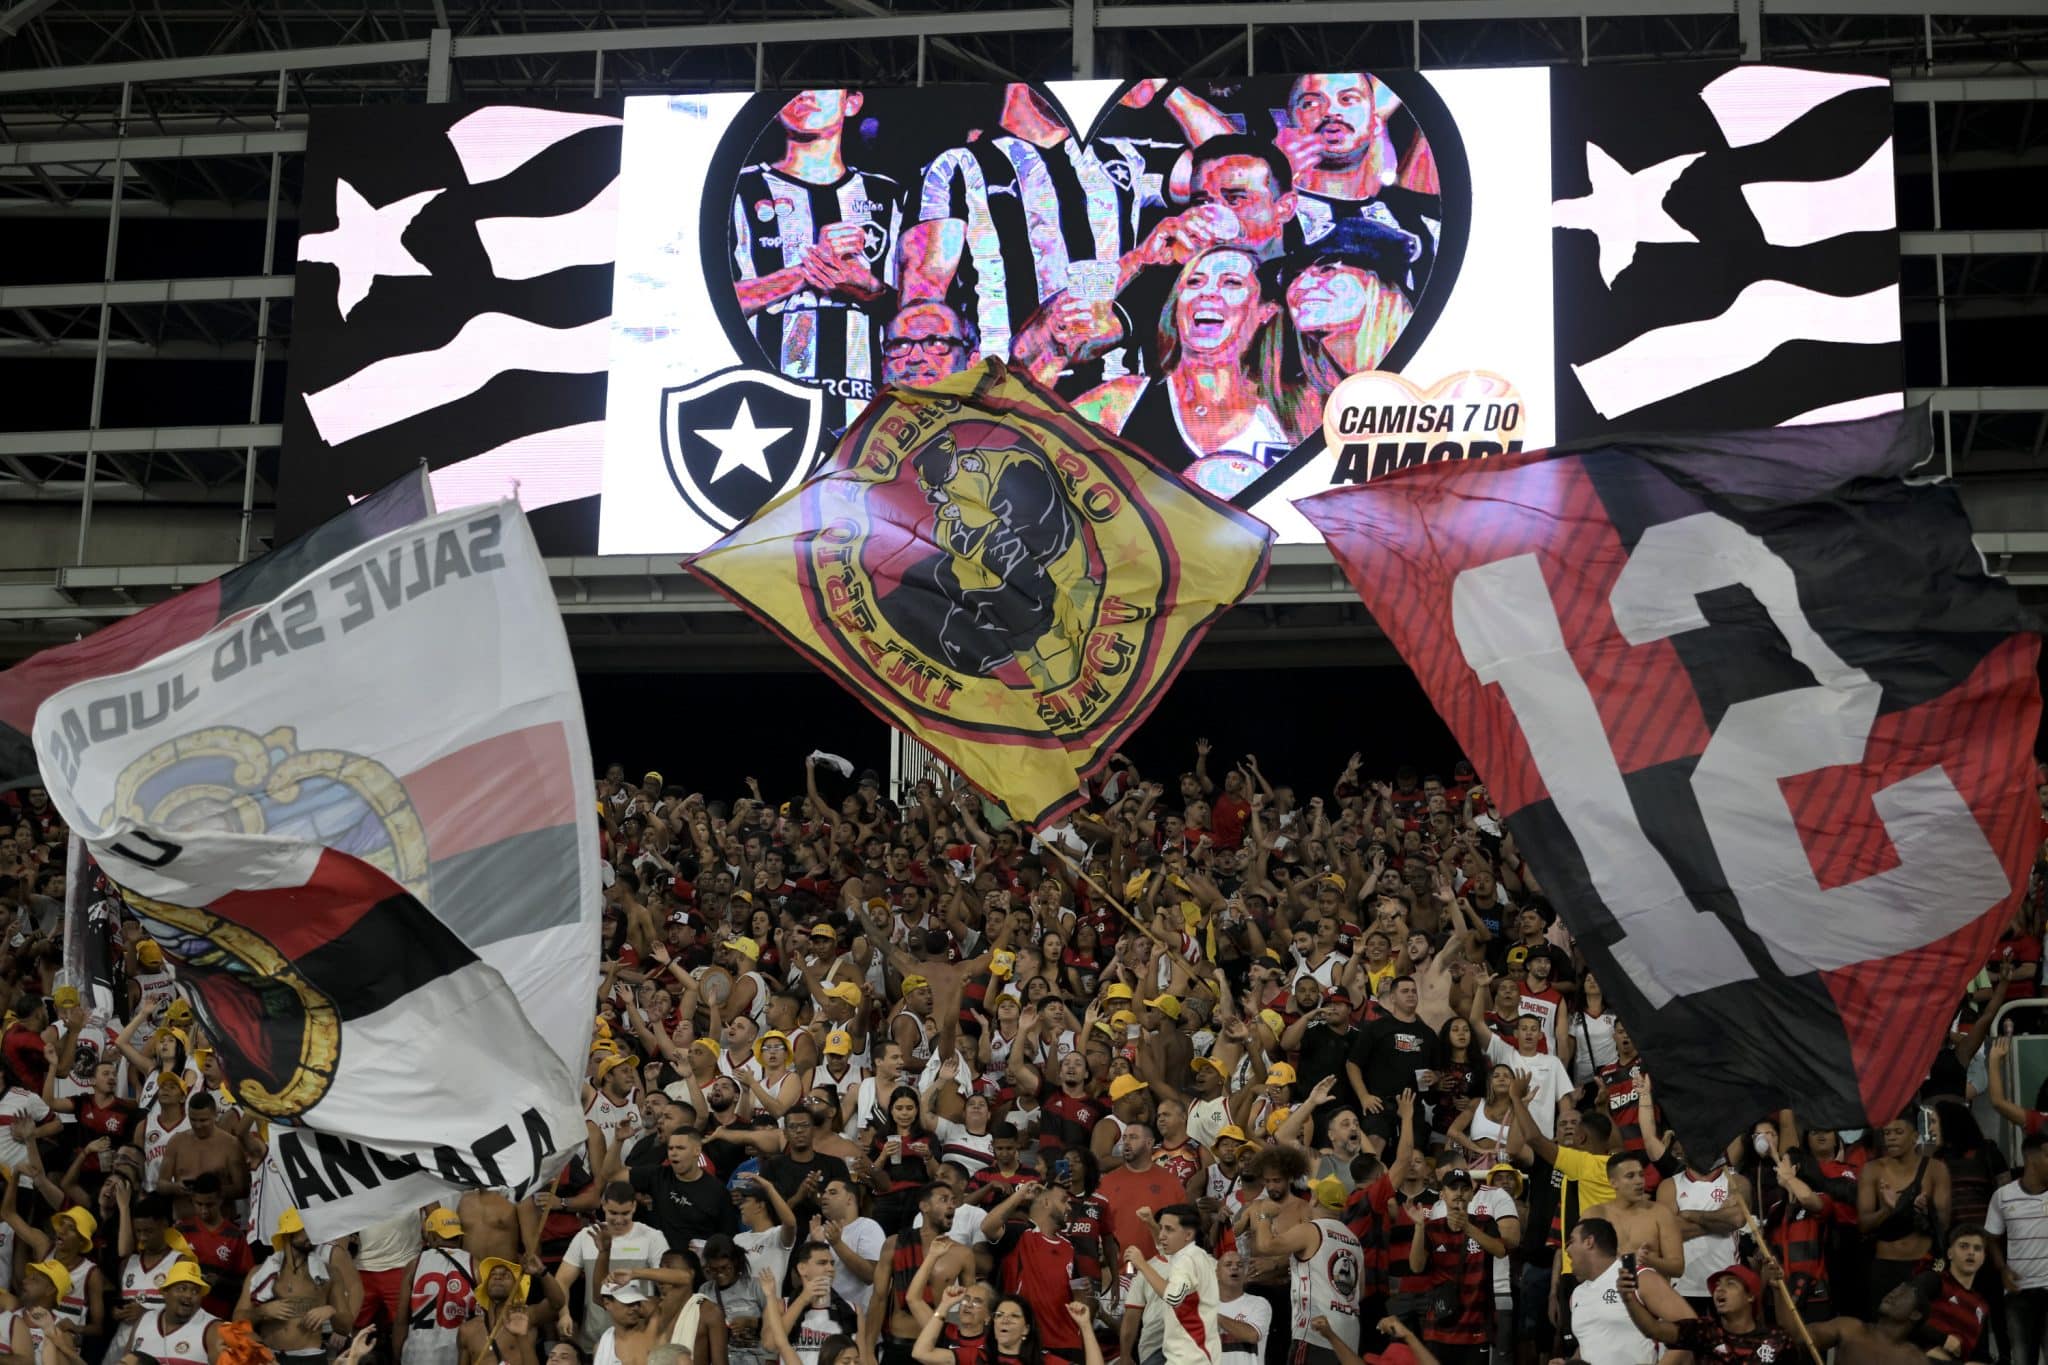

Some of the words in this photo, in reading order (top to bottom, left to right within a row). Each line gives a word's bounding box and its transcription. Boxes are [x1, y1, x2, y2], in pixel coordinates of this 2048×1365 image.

[1339, 404, 1454, 434] CAMISA
[1462, 404, 1481, 432] 7
[1484, 402, 1520, 432] DO
[1450, 510, 2013, 1012] 12
